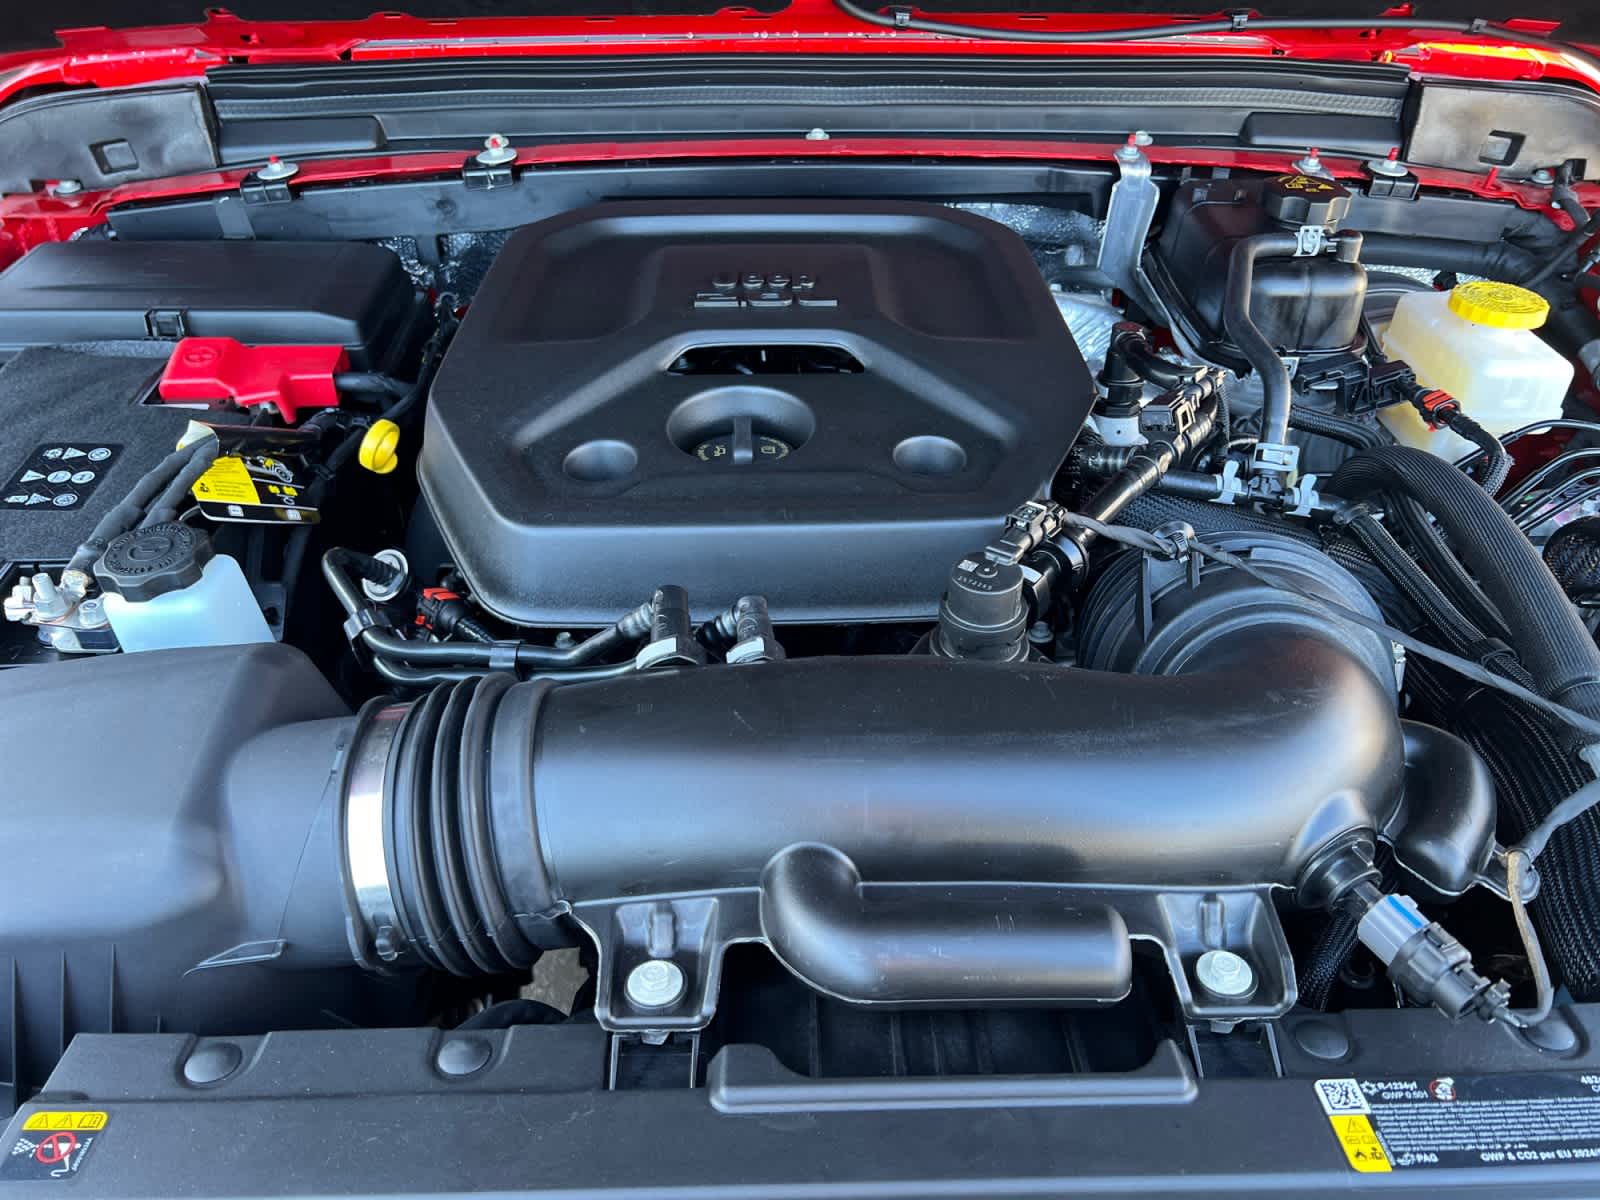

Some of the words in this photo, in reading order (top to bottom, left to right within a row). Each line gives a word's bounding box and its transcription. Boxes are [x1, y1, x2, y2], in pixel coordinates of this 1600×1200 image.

[1480, 1151, 1505, 1161] GWP
[1516, 1150, 1540, 1161] CO2
[1539, 1151, 1557, 1161] per
[1555, 1148, 1573, 1159] EU
